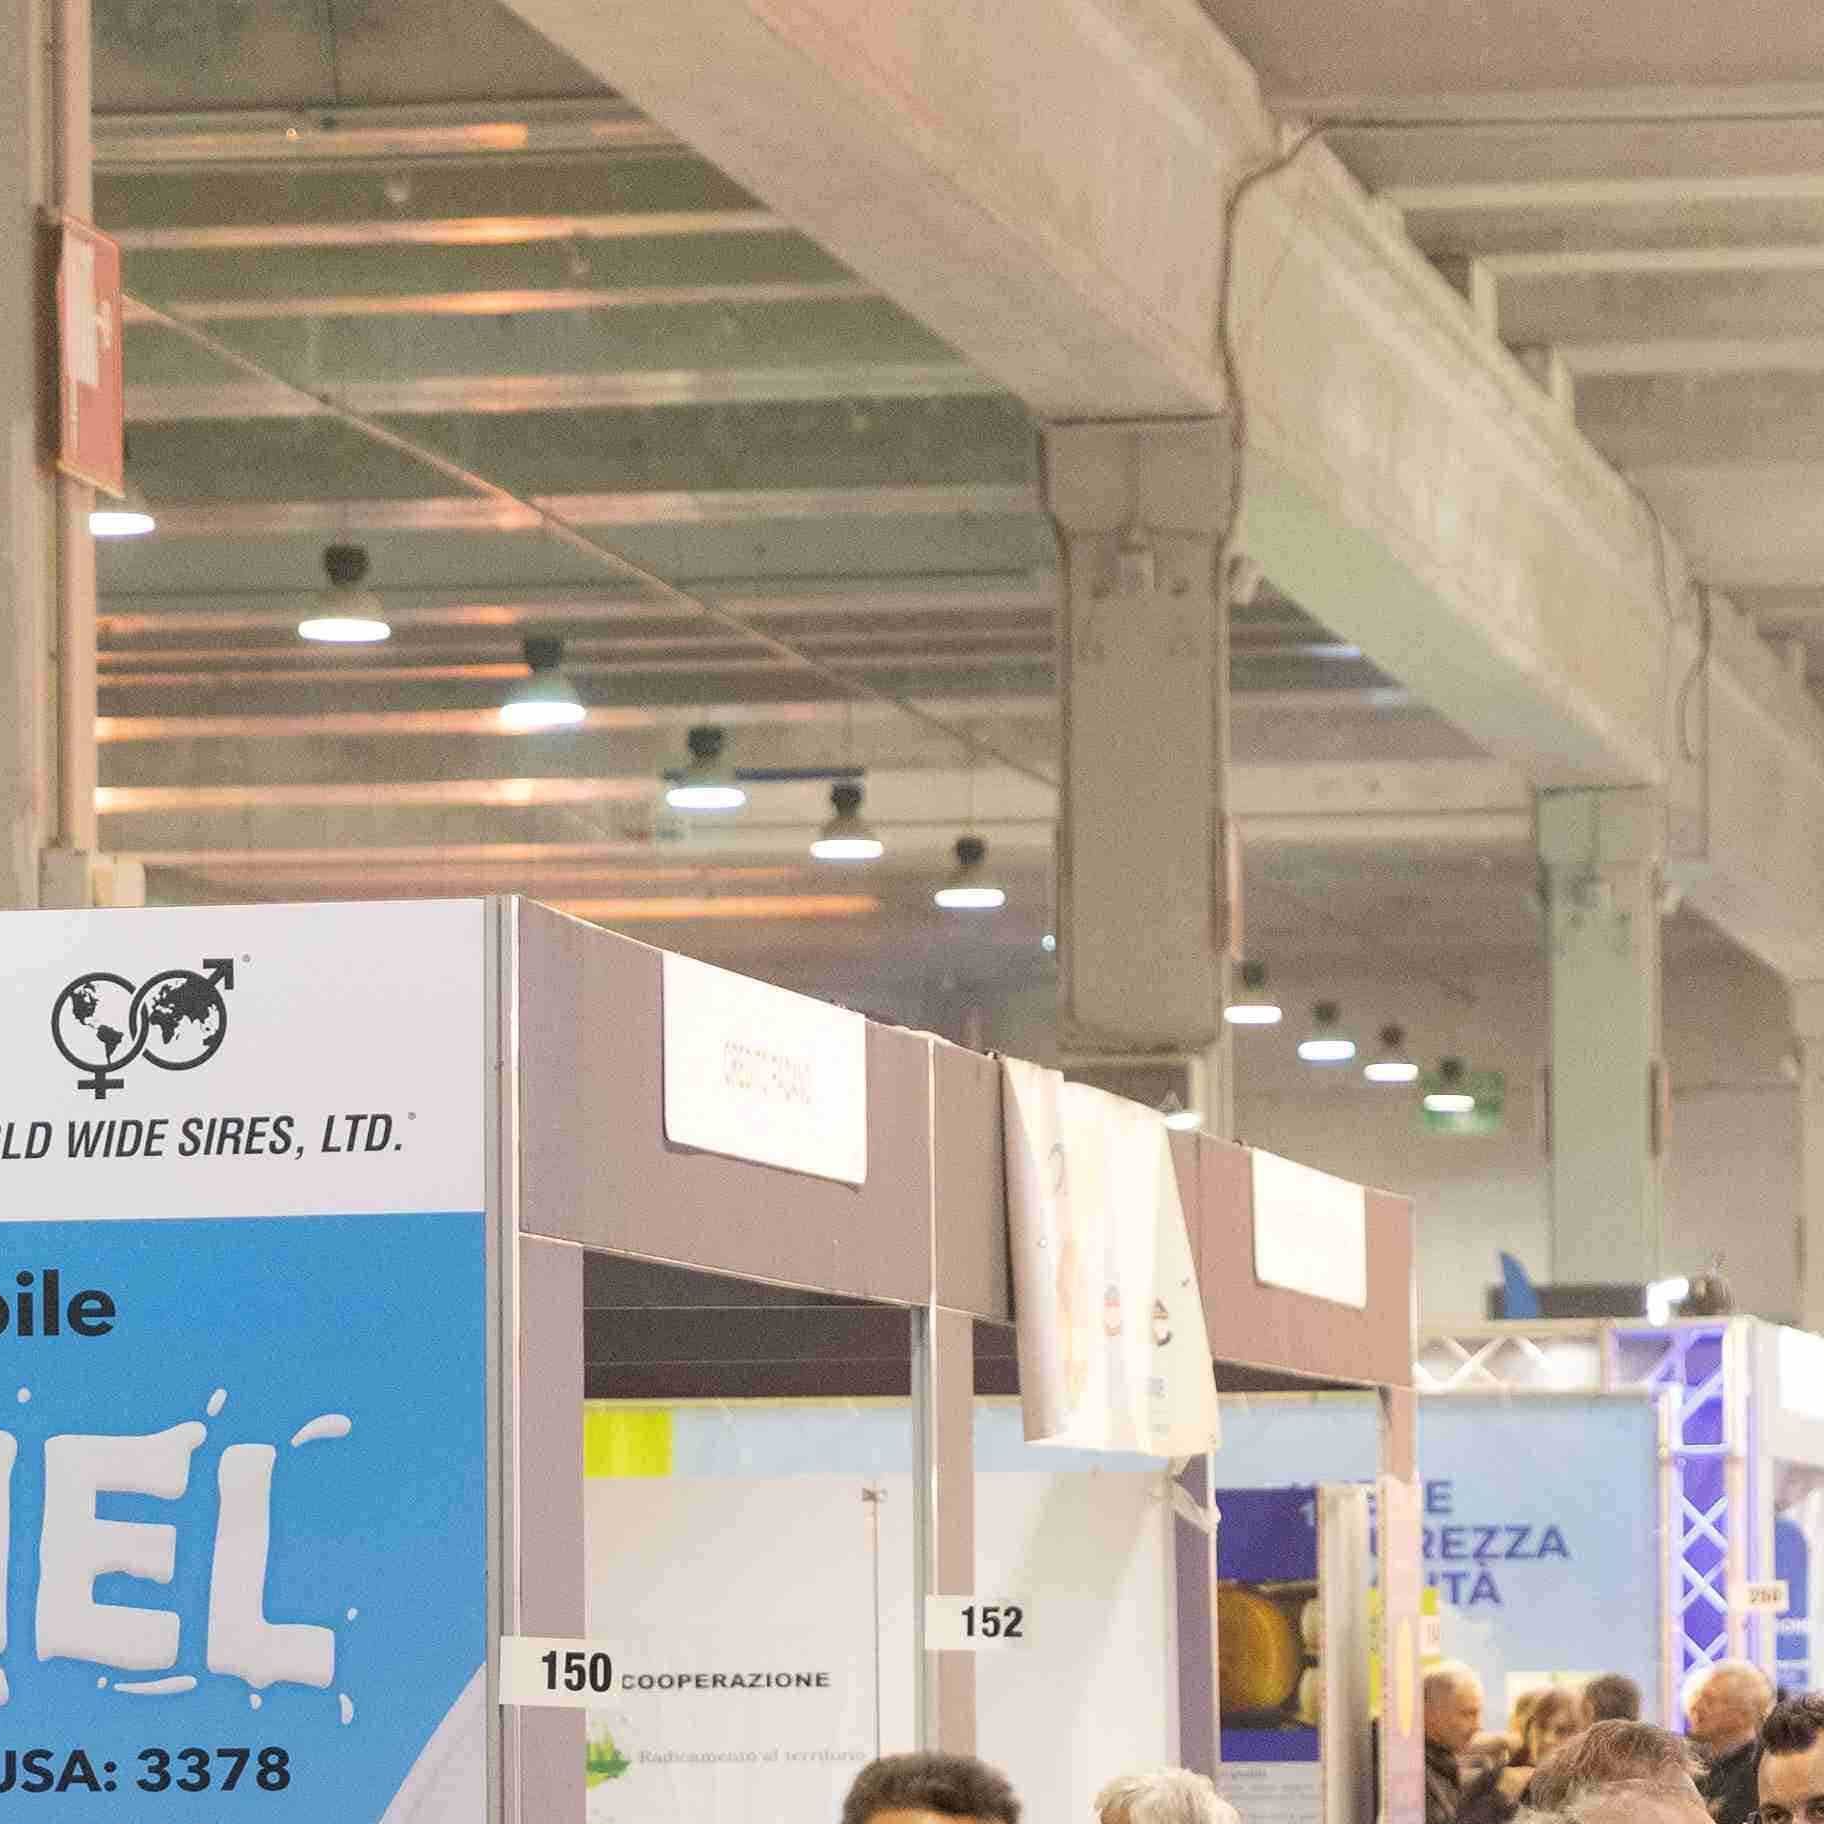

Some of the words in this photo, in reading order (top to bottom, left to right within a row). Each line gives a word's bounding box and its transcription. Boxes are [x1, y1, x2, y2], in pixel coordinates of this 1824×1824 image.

[67, 1118, 169, 1159] WIDE
[179, 1116, 303, 1159] SIRES,
[322, 1114, 401, 1152] LTD.
[960, 1605, 1024, 1638] 152
[540, 1650, 613, 1693] 150
[621, 1672, 832, 1691] COOPERAZIONE
[137, 1747, 290, 1792] 3378
